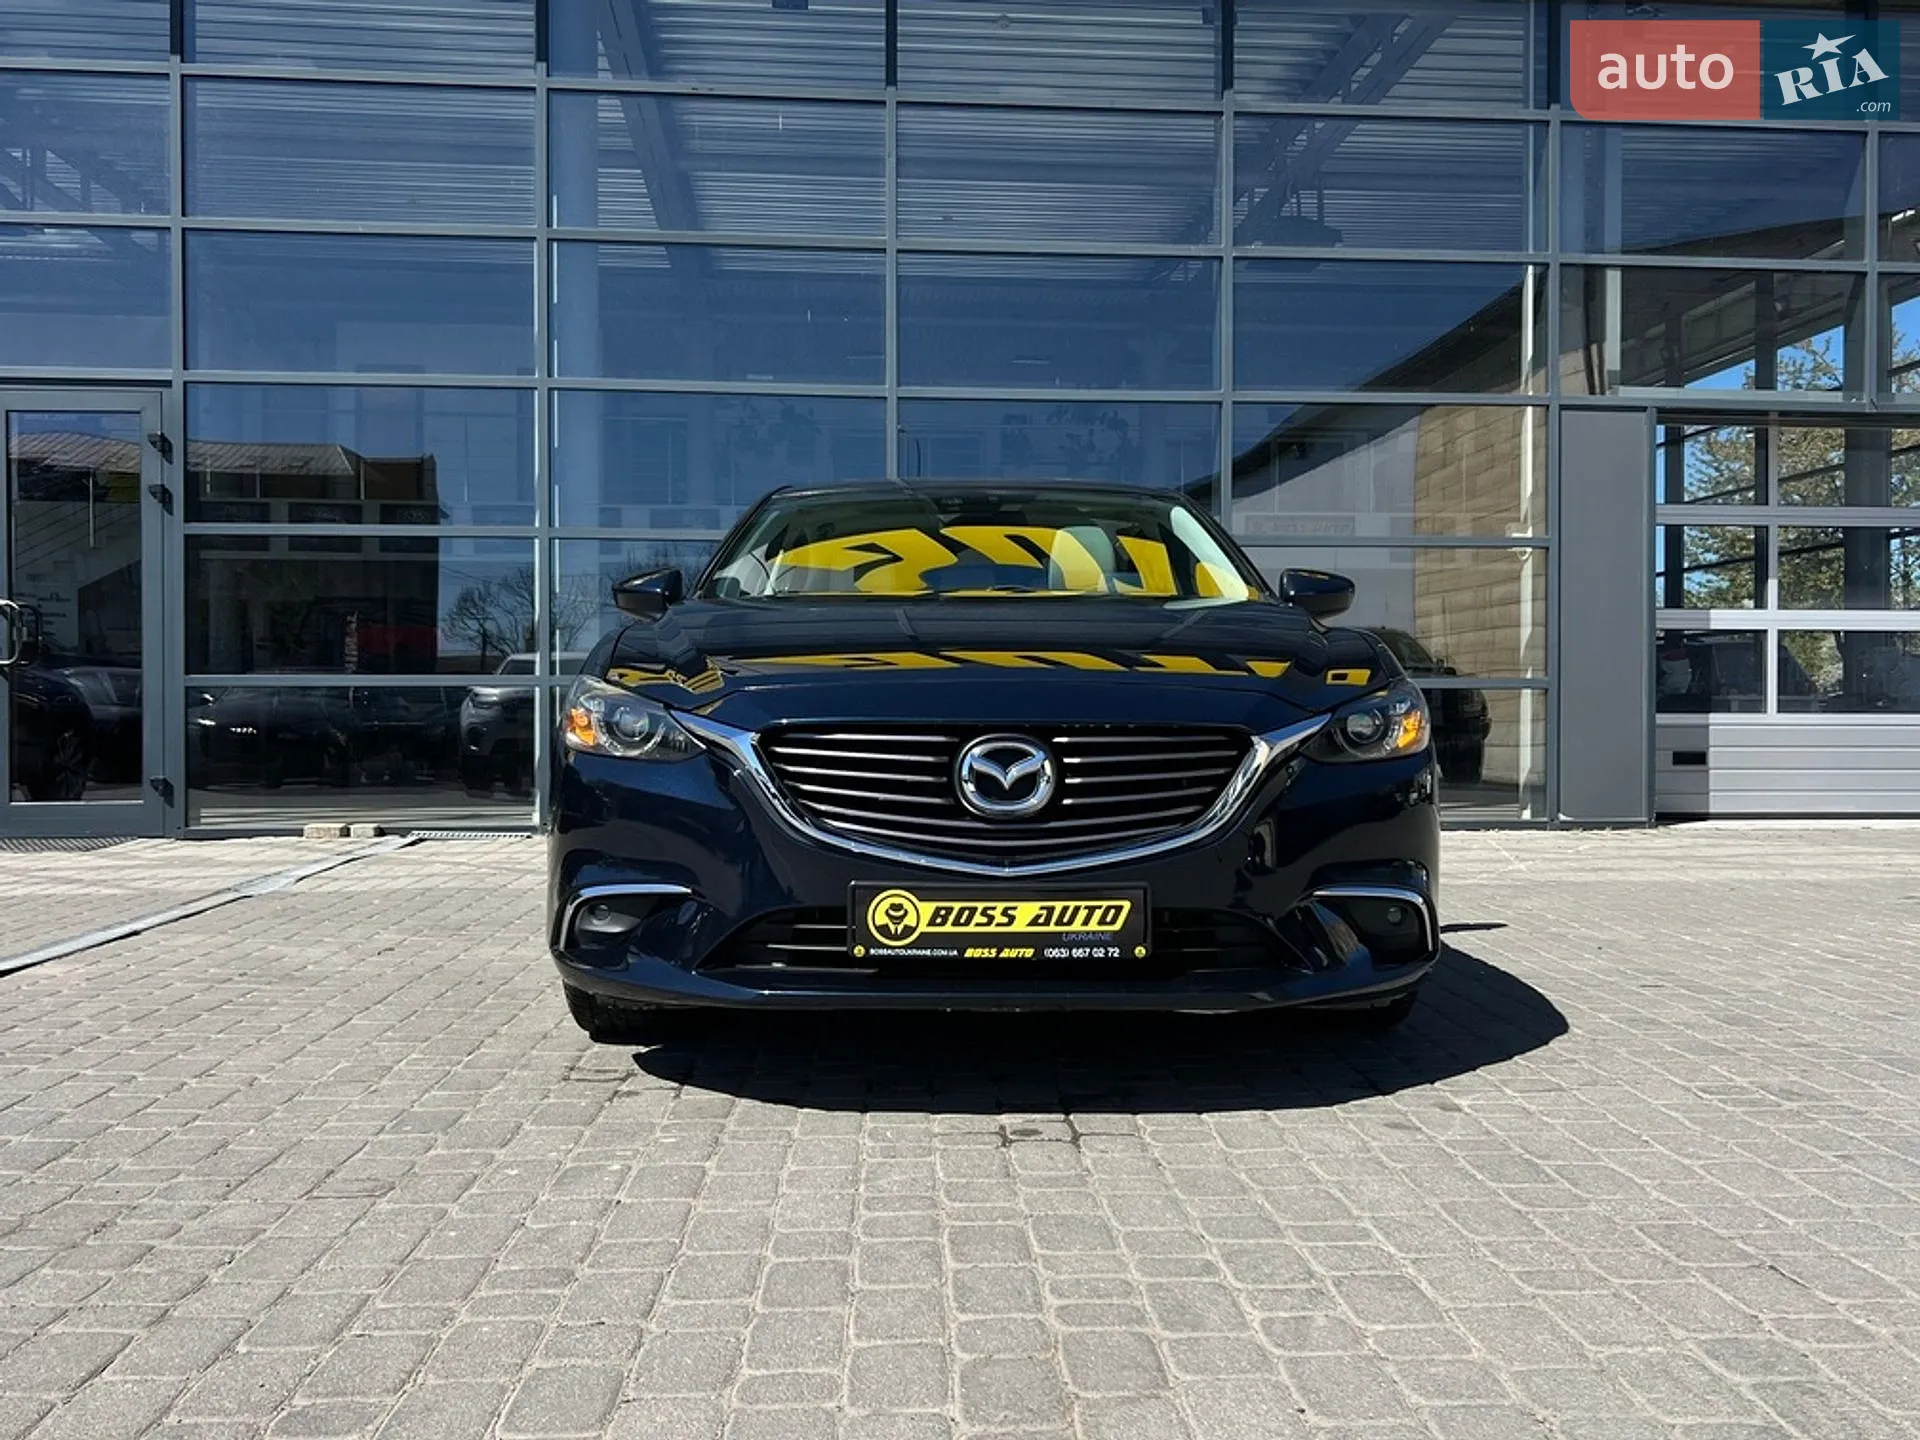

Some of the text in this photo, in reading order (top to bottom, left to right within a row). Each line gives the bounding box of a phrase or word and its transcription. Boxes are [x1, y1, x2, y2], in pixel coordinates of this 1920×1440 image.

[926, 904, 1125, 928] BOSS AUTO
[1062, 932, 1113, 942] UKRAINE
[964, 947, 1035, 958] BOSS AUTO
[1107, 946, 1120, 958] 72
